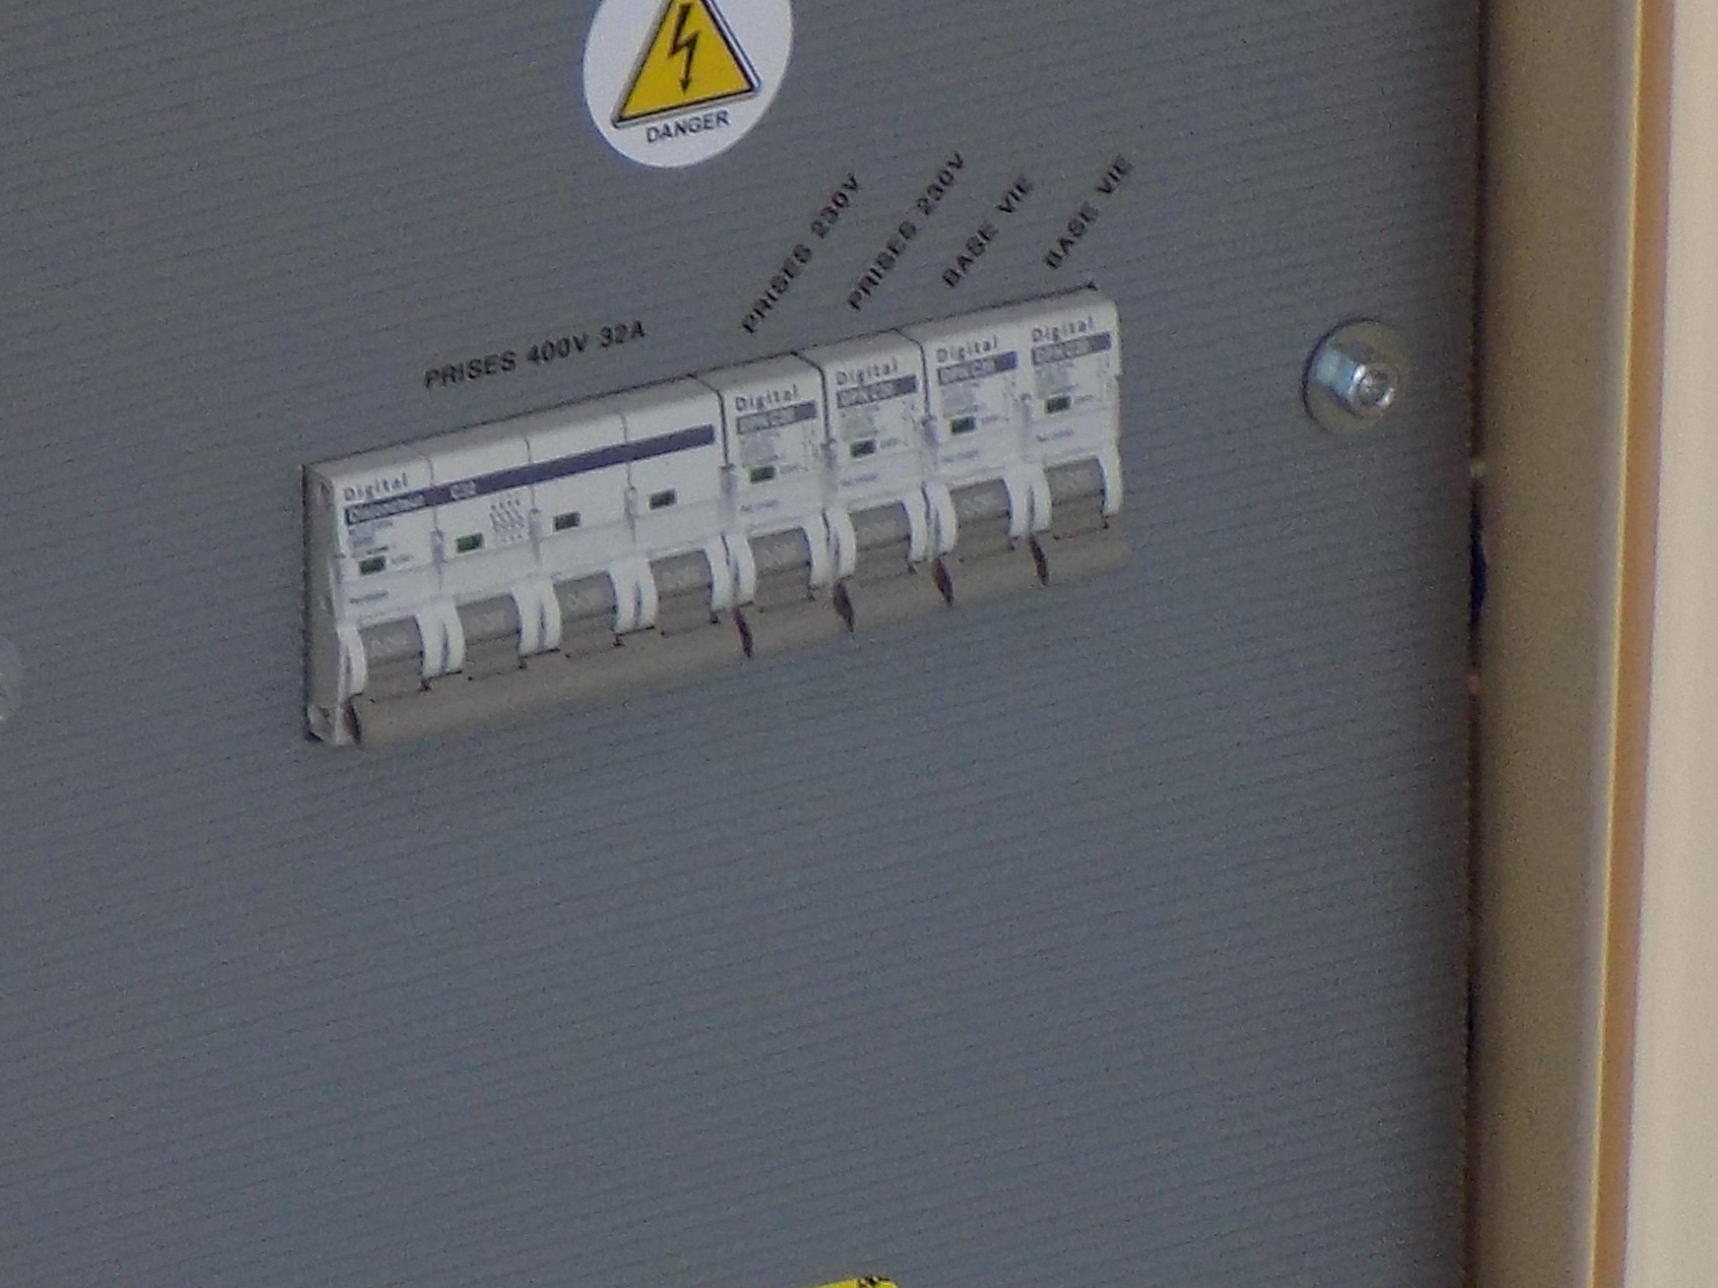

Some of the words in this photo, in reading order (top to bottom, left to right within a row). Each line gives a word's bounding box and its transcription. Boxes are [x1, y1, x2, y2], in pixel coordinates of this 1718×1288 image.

[645, 110, 731, 144] DANGER
[1044, 200, 1101, 270] BASE
[1096, 152, 1135, 196] VIE
[847, 219, 919, 311] PRISES
[915, 150, 966, 216] 230V
[941, 220, 999, 288] BASE
[995, 175, 1035, 214] VIE
[740, 243, 813, 334] PRISES
[809, 170, 861, 239] 230V
[1031, 316, 1095, 344] Digital
[424, 350, 517, 390] PRISES
[526, 333, 590, 364] 400V
[599, 319, 646, 348] 32A
[935, 335, 998, 363] Digital
[835, 358, 899, 386] Digital
[734, 383, 799, 412] Digital
[343, 471, 408, 502] Digital
